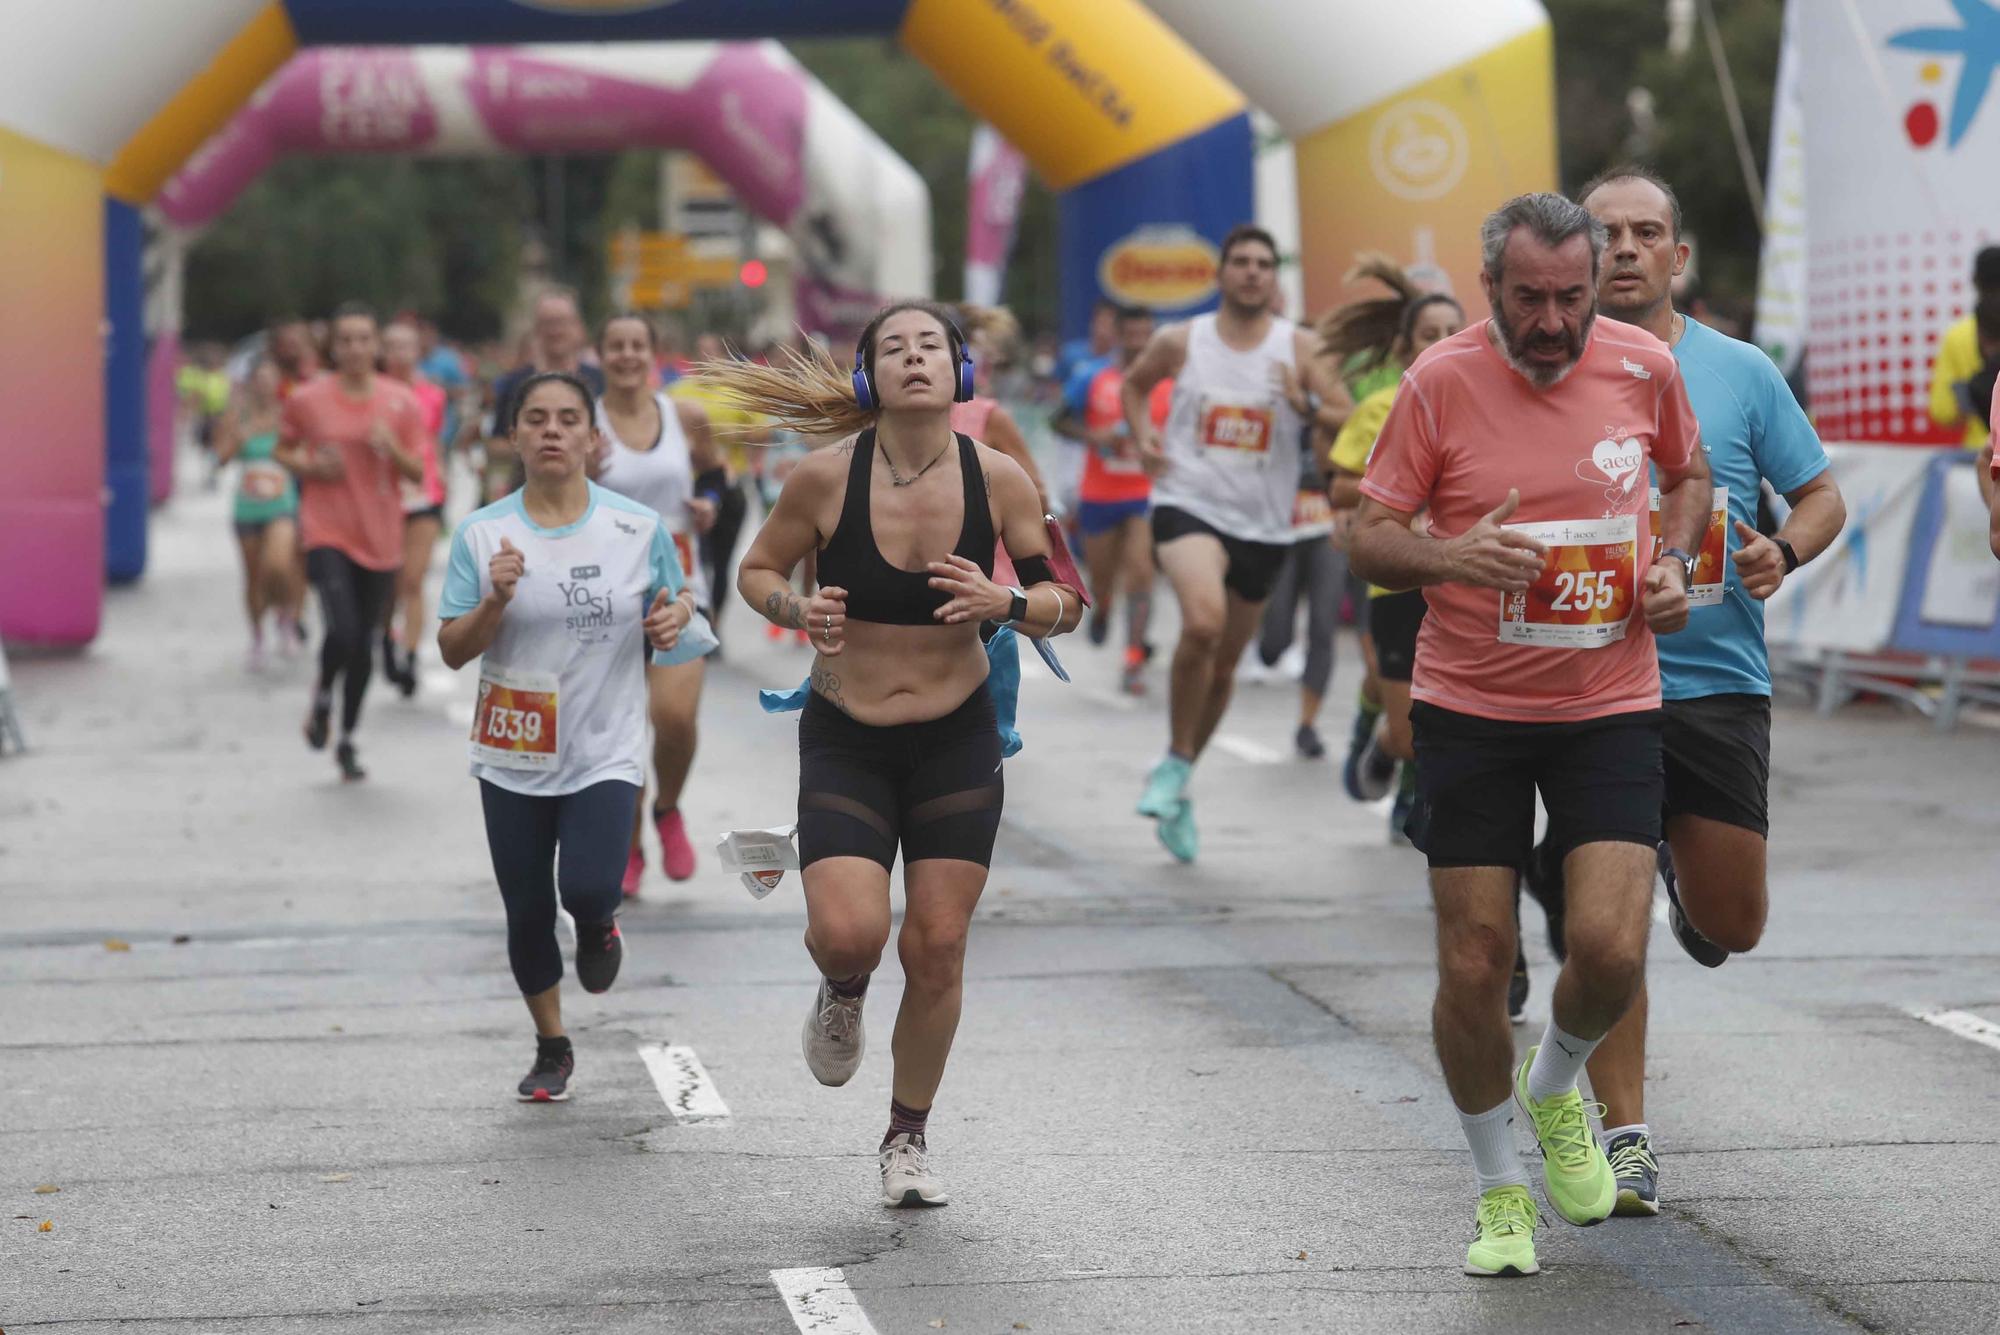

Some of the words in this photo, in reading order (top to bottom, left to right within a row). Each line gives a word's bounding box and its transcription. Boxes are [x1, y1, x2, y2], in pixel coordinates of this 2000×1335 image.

[1602, 454, 1640, 470] aecc
[557, 581, 590, 607] Yo
[1513, 595, 1526, 605] CA
[1550, 569, 1616, 612] 255
[1508, 604, 1527, 614] RRE
[487, 705, 543, 743] 1339
